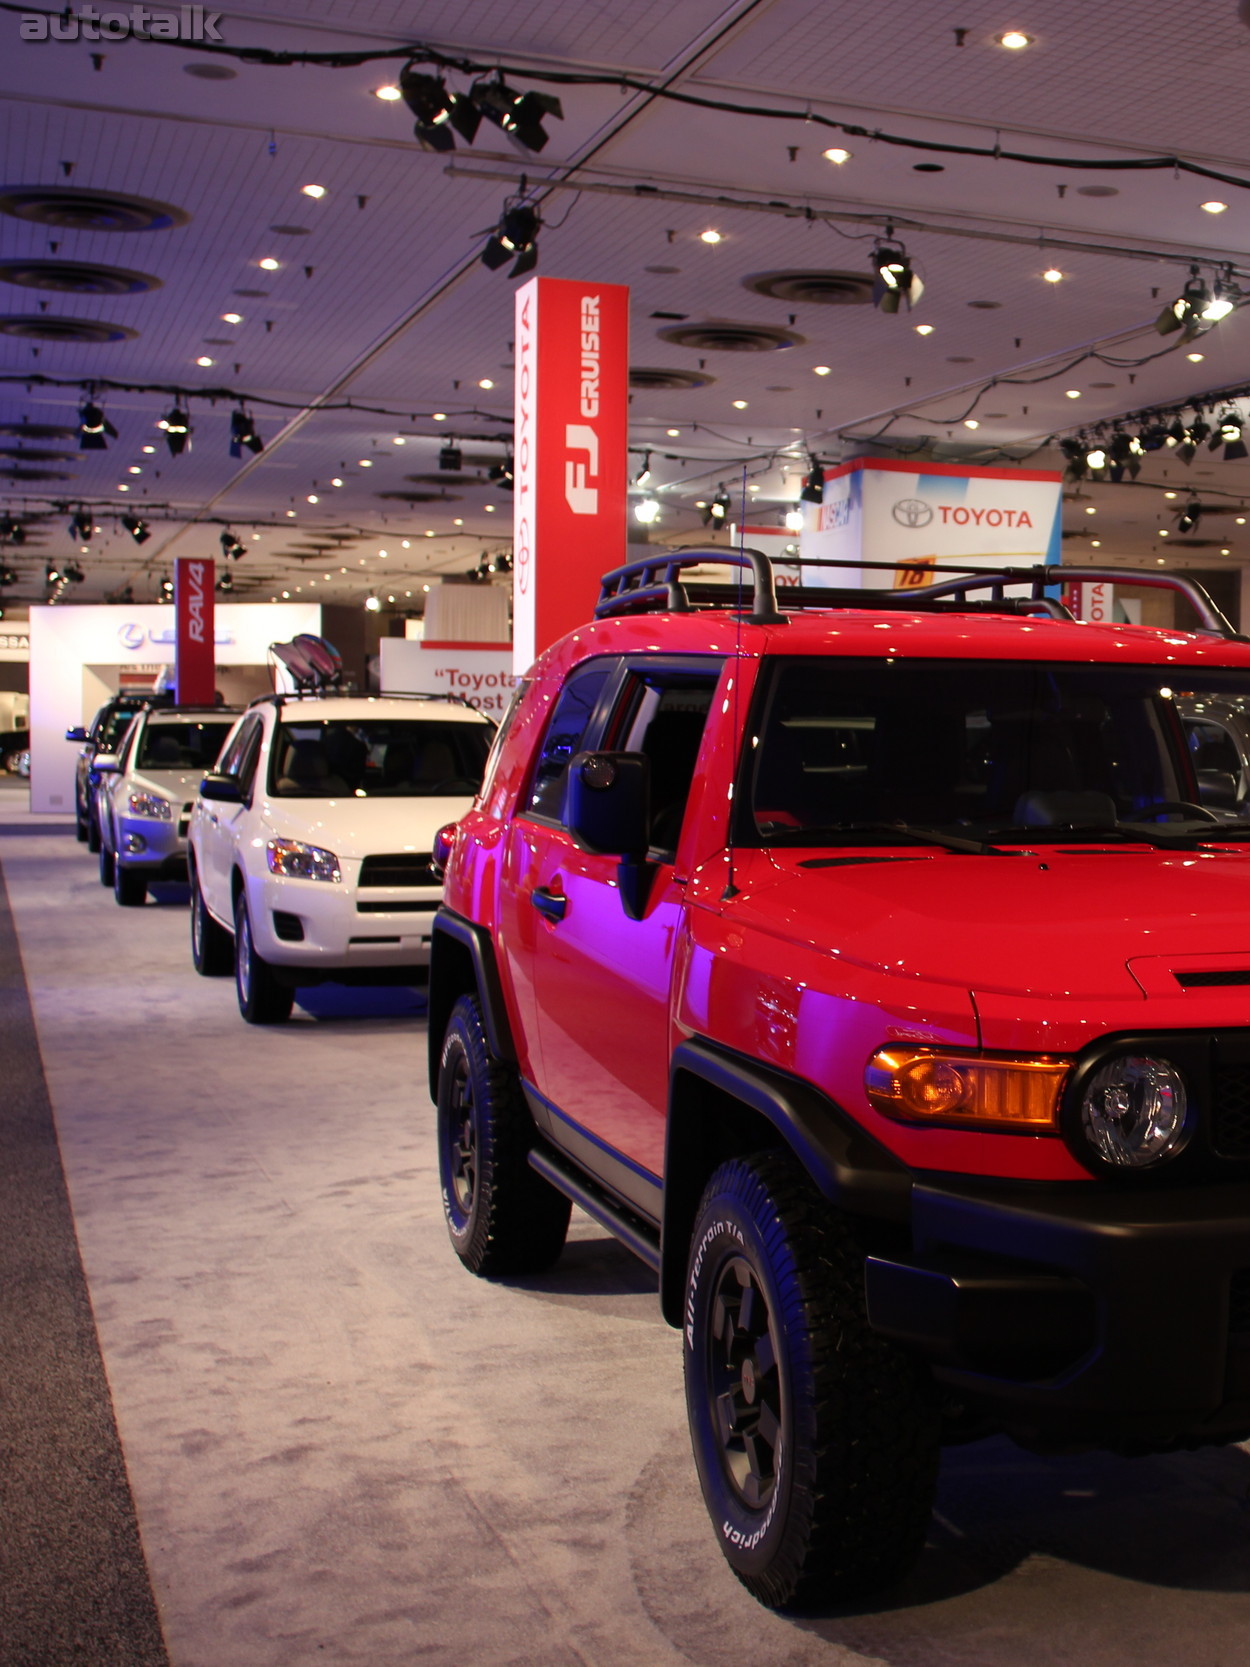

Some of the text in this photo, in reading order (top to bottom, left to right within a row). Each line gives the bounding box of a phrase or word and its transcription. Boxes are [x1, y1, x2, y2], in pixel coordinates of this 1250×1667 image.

[520, 296, 530, 505] TOYOTA
[565, 295, 600, 515] FJ CRUISER
[938, 506, 1032, 528] TOYOTA
[189, 562, 205, 643] RAV4
[447, 692, 503, 709] Most
